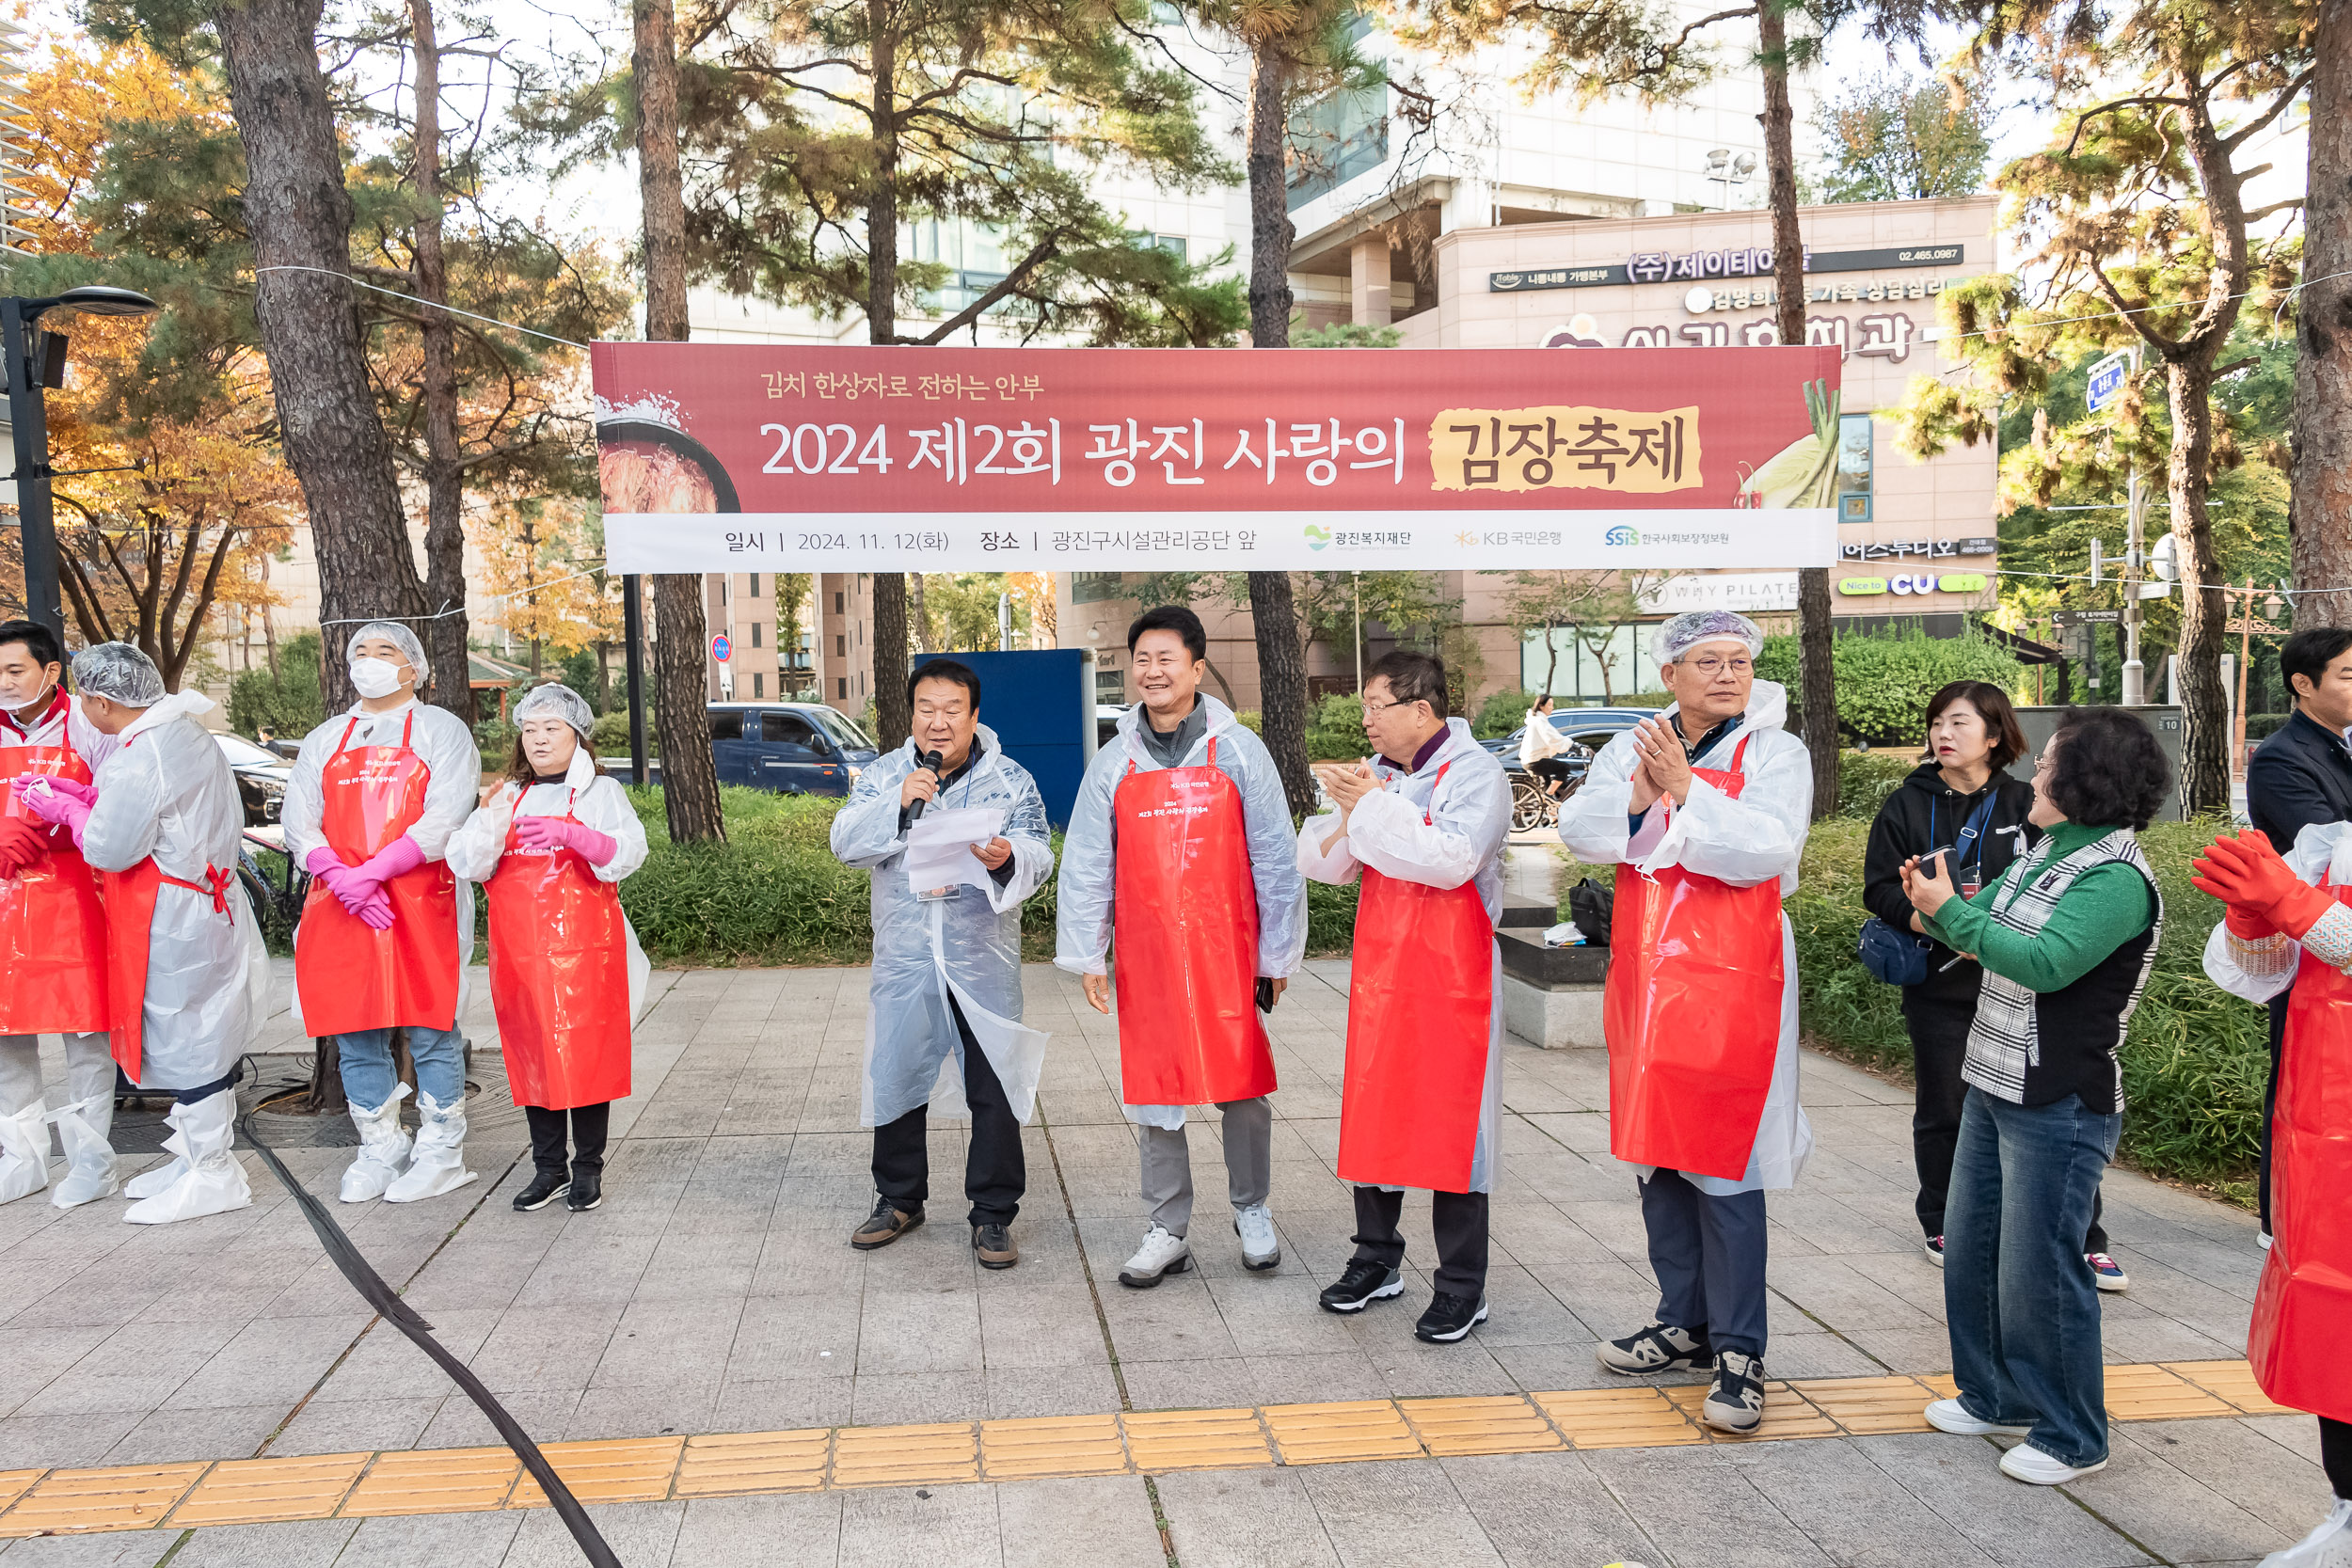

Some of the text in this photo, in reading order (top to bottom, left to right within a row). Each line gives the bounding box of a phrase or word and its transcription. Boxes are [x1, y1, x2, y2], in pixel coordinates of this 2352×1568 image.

[1713, 285, 1771, 310] 김명희
[1820, 283, 1859, 303] 가족
[761, 371, 1044, 401] 김치 한상자로 전하는 안부
[760, 416, 1684, 486] 2024 제2회 광진 사랑의 김장축제
[725, 531, 949, 552] 일시 2024. 11. 12(화)
[980, 530, 1257, 551] 장소 광진구시설관리공단 앞
[1335, 531, 1411, 546] 광진복지재단
[1484, 531, 1562, 546] KB 국민은행
[1642, 532, 1729, 546] 한국사회보장정보원
[1838, 537, 1957, 562] 어스투디오
[1675, 585, 1717, 598] WHY
[1846, 582, 1868, 591] Nice
[1891, 573, 1935, 595] CU
[2166, 721, 2177, 730] 10
